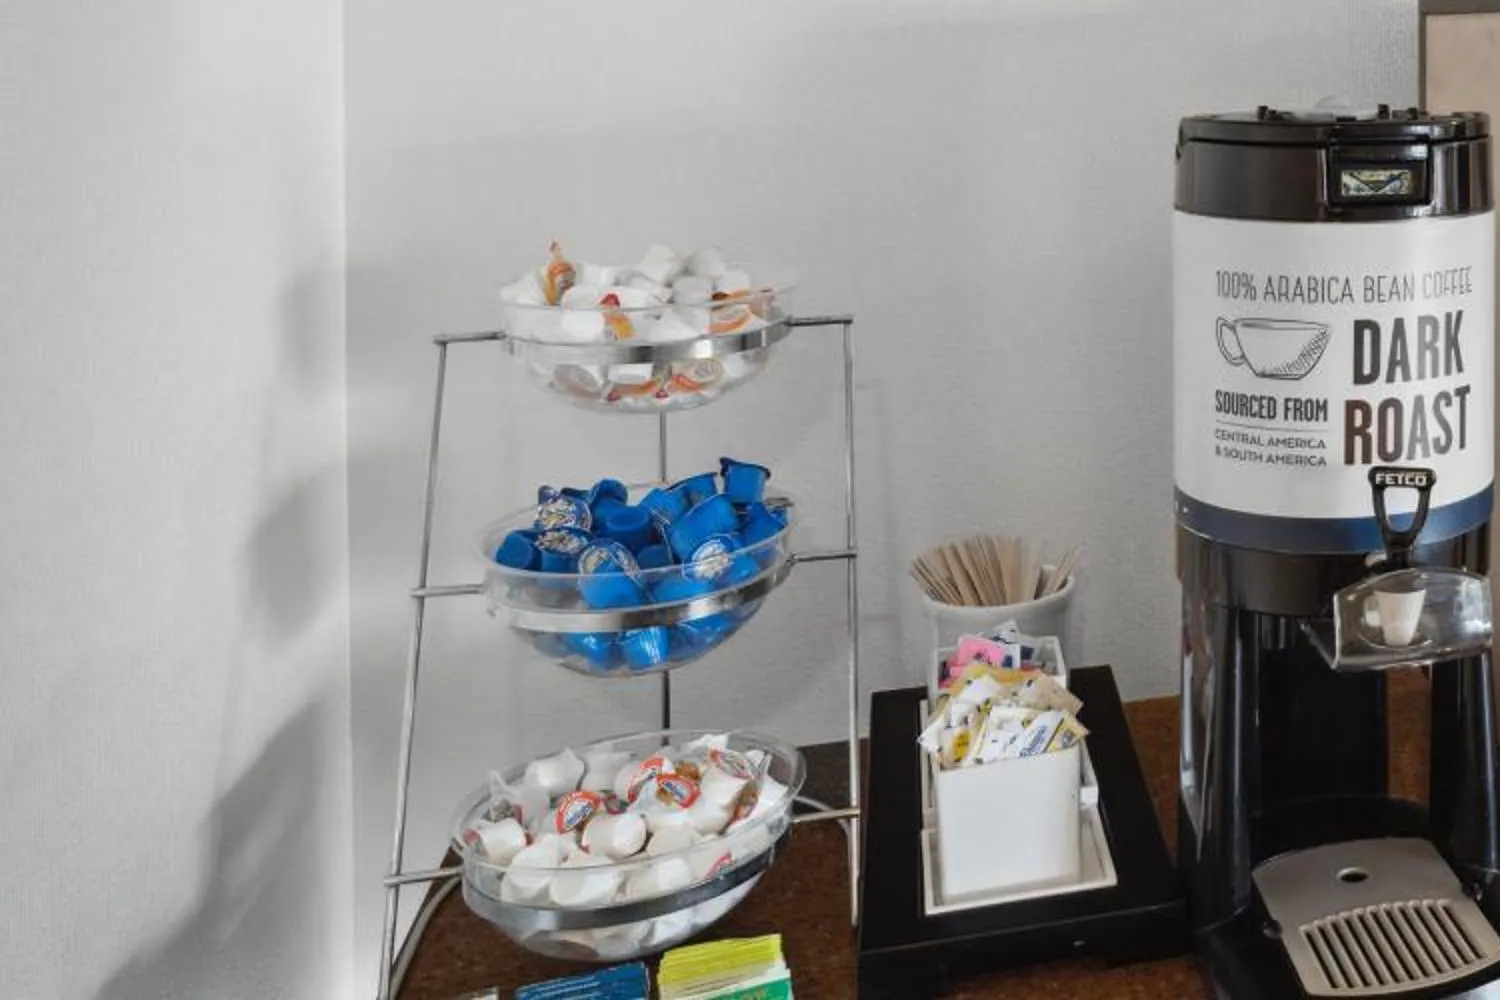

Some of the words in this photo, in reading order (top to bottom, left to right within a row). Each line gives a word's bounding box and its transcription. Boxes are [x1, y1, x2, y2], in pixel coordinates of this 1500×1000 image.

[1215, 269, 1257, 301] 100%
[1263, 275, 1354, 304] ARABICA
[1363, 275, 1415, 303] BEAN
[1422, 266, 1473, 299] COFFEE
[1353, 310, 1464, 386] DARK
[1215, 389, 1277, 420] SOURCED
[1283, 397, 1328, 422] FROM
[1214, 428, 1264, 446] CENTRAL
[1267, 434, 1327, 450] AMERICA
[1344, 384, 1471, 465] ROAST
[1222, 447, 1263, 463] SOUTH
[1266, 452, 1327, 468] AMERICA
[1375, 472, 1428, 487] FETCO
